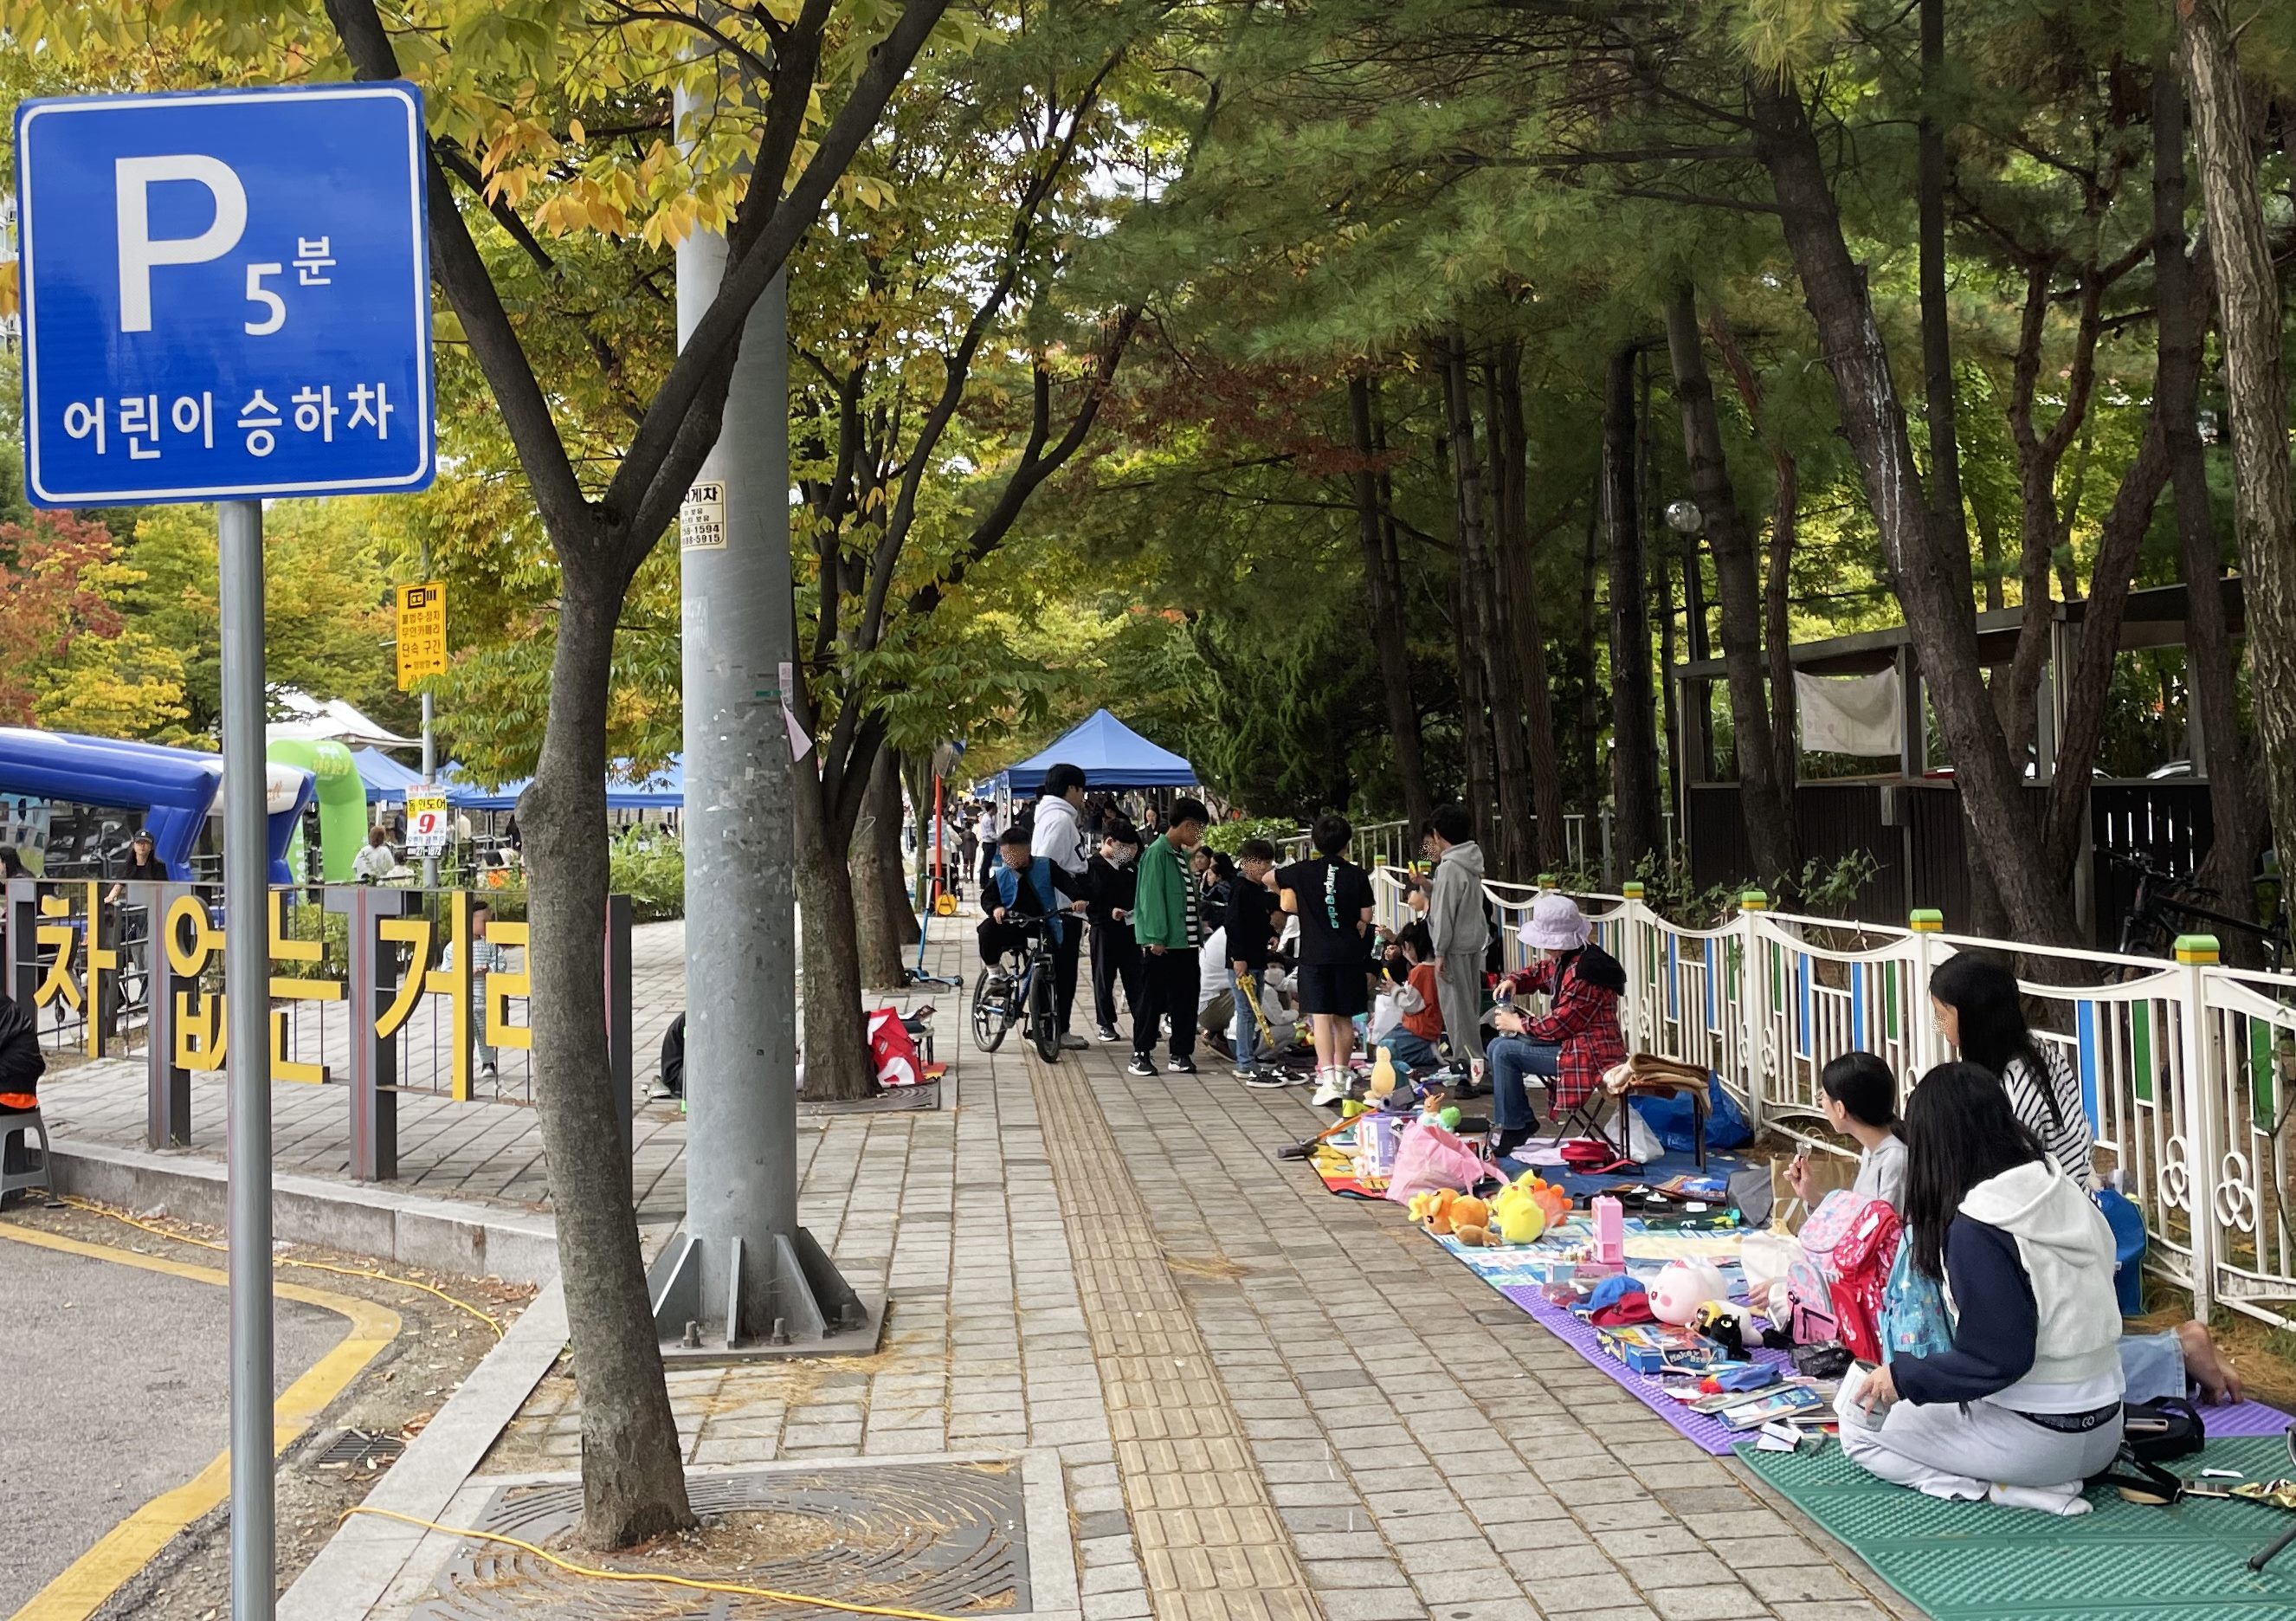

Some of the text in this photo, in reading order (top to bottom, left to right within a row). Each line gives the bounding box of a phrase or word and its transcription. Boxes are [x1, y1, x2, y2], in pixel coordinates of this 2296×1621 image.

[114, 153, 248, 333] P
[63, 382, 395, 461] 어린이 승하차
[423, 639, 441, 656] 구간
[418, 798, 446, 811] 인도어
[418, 813, 435, 835] 9
[33, 882, 117, 1058] 차
